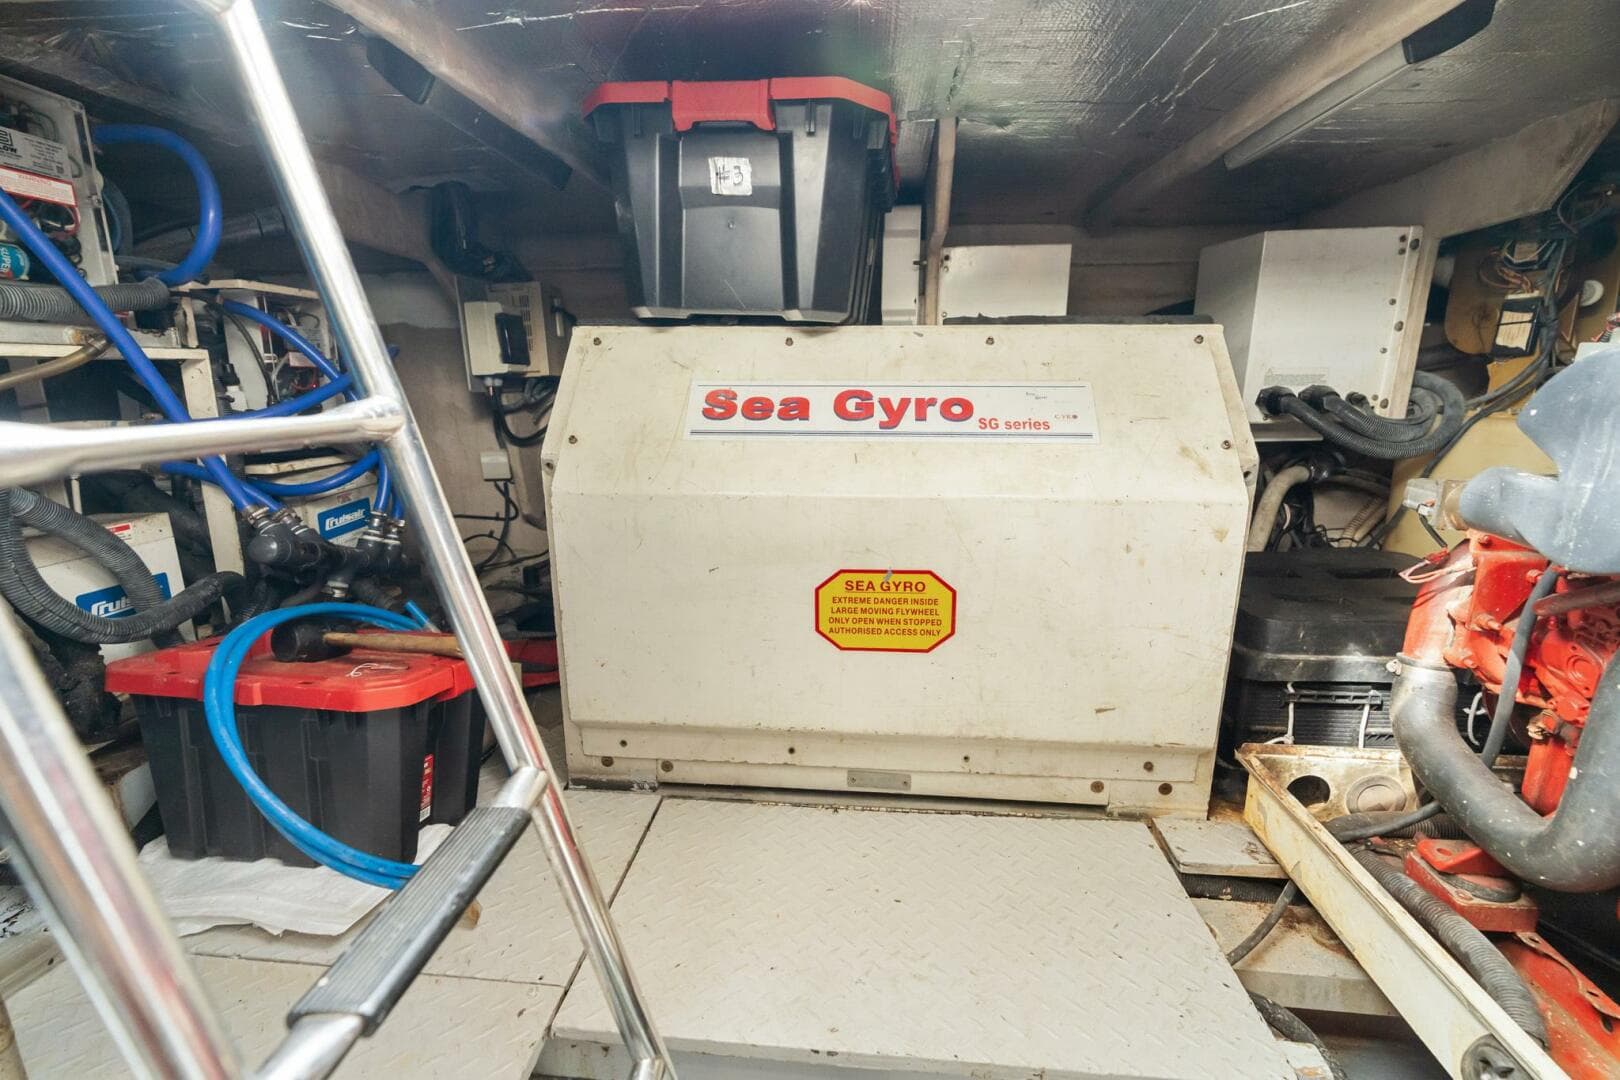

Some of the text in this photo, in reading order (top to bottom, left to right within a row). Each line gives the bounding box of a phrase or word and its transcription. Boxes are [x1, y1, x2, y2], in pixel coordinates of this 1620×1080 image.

[716, 165, 744, 186] #3
[701, 388, 974, 430] Sea Gyro
[978, 417, 1051, 431] SG series
[325, 508, 366, 532] Cruisair
[845, 580, 926, 592] SEA GYRO
[91, 595, 129, 617] Crui
[832, 596, 939, 606] EXTREME DANGER INSIDE
[831, 607, 940, 616] LARGE MOVING FLYWHEEL
[828, 617, 942, 626] ONLY OPEN WHEN STOPPED
[828, 627, 941, 637] AUTHORISED ACCESS ONLY
